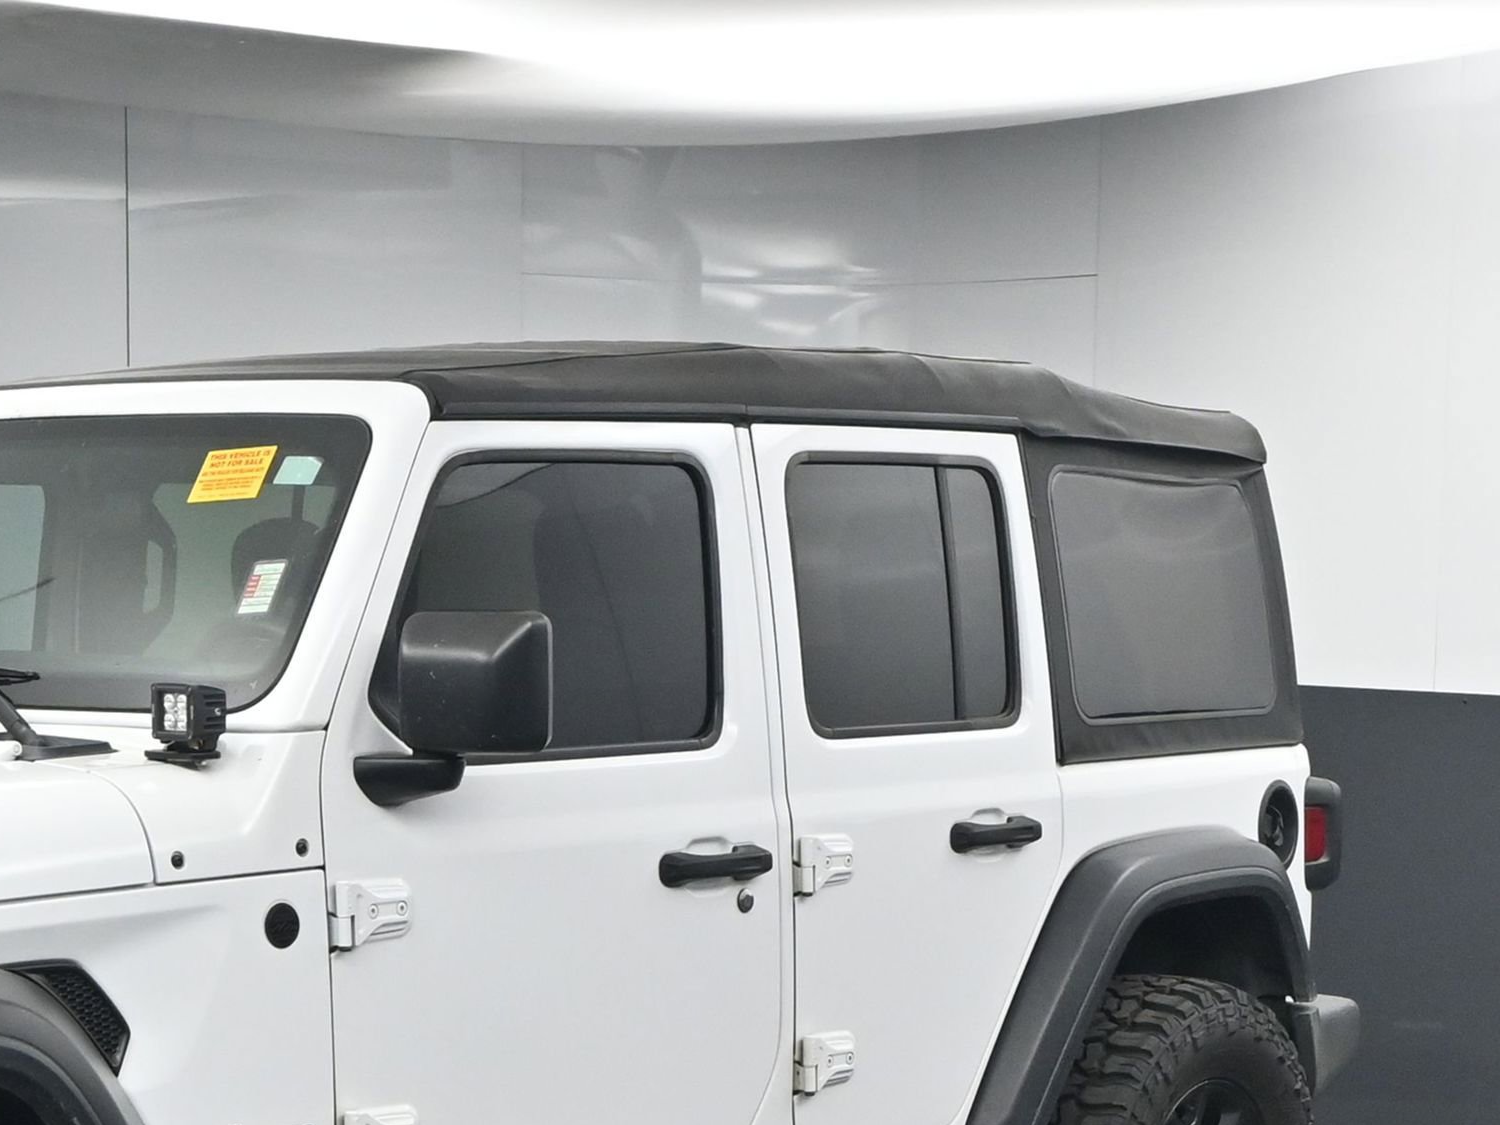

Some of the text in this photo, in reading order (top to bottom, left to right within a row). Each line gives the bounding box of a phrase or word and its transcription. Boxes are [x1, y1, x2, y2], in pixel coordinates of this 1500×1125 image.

[230, 450, 262, 459] VEHICLE
[227, 459, 243, 467] FOR
[244, 458, 264, 466] SALE
